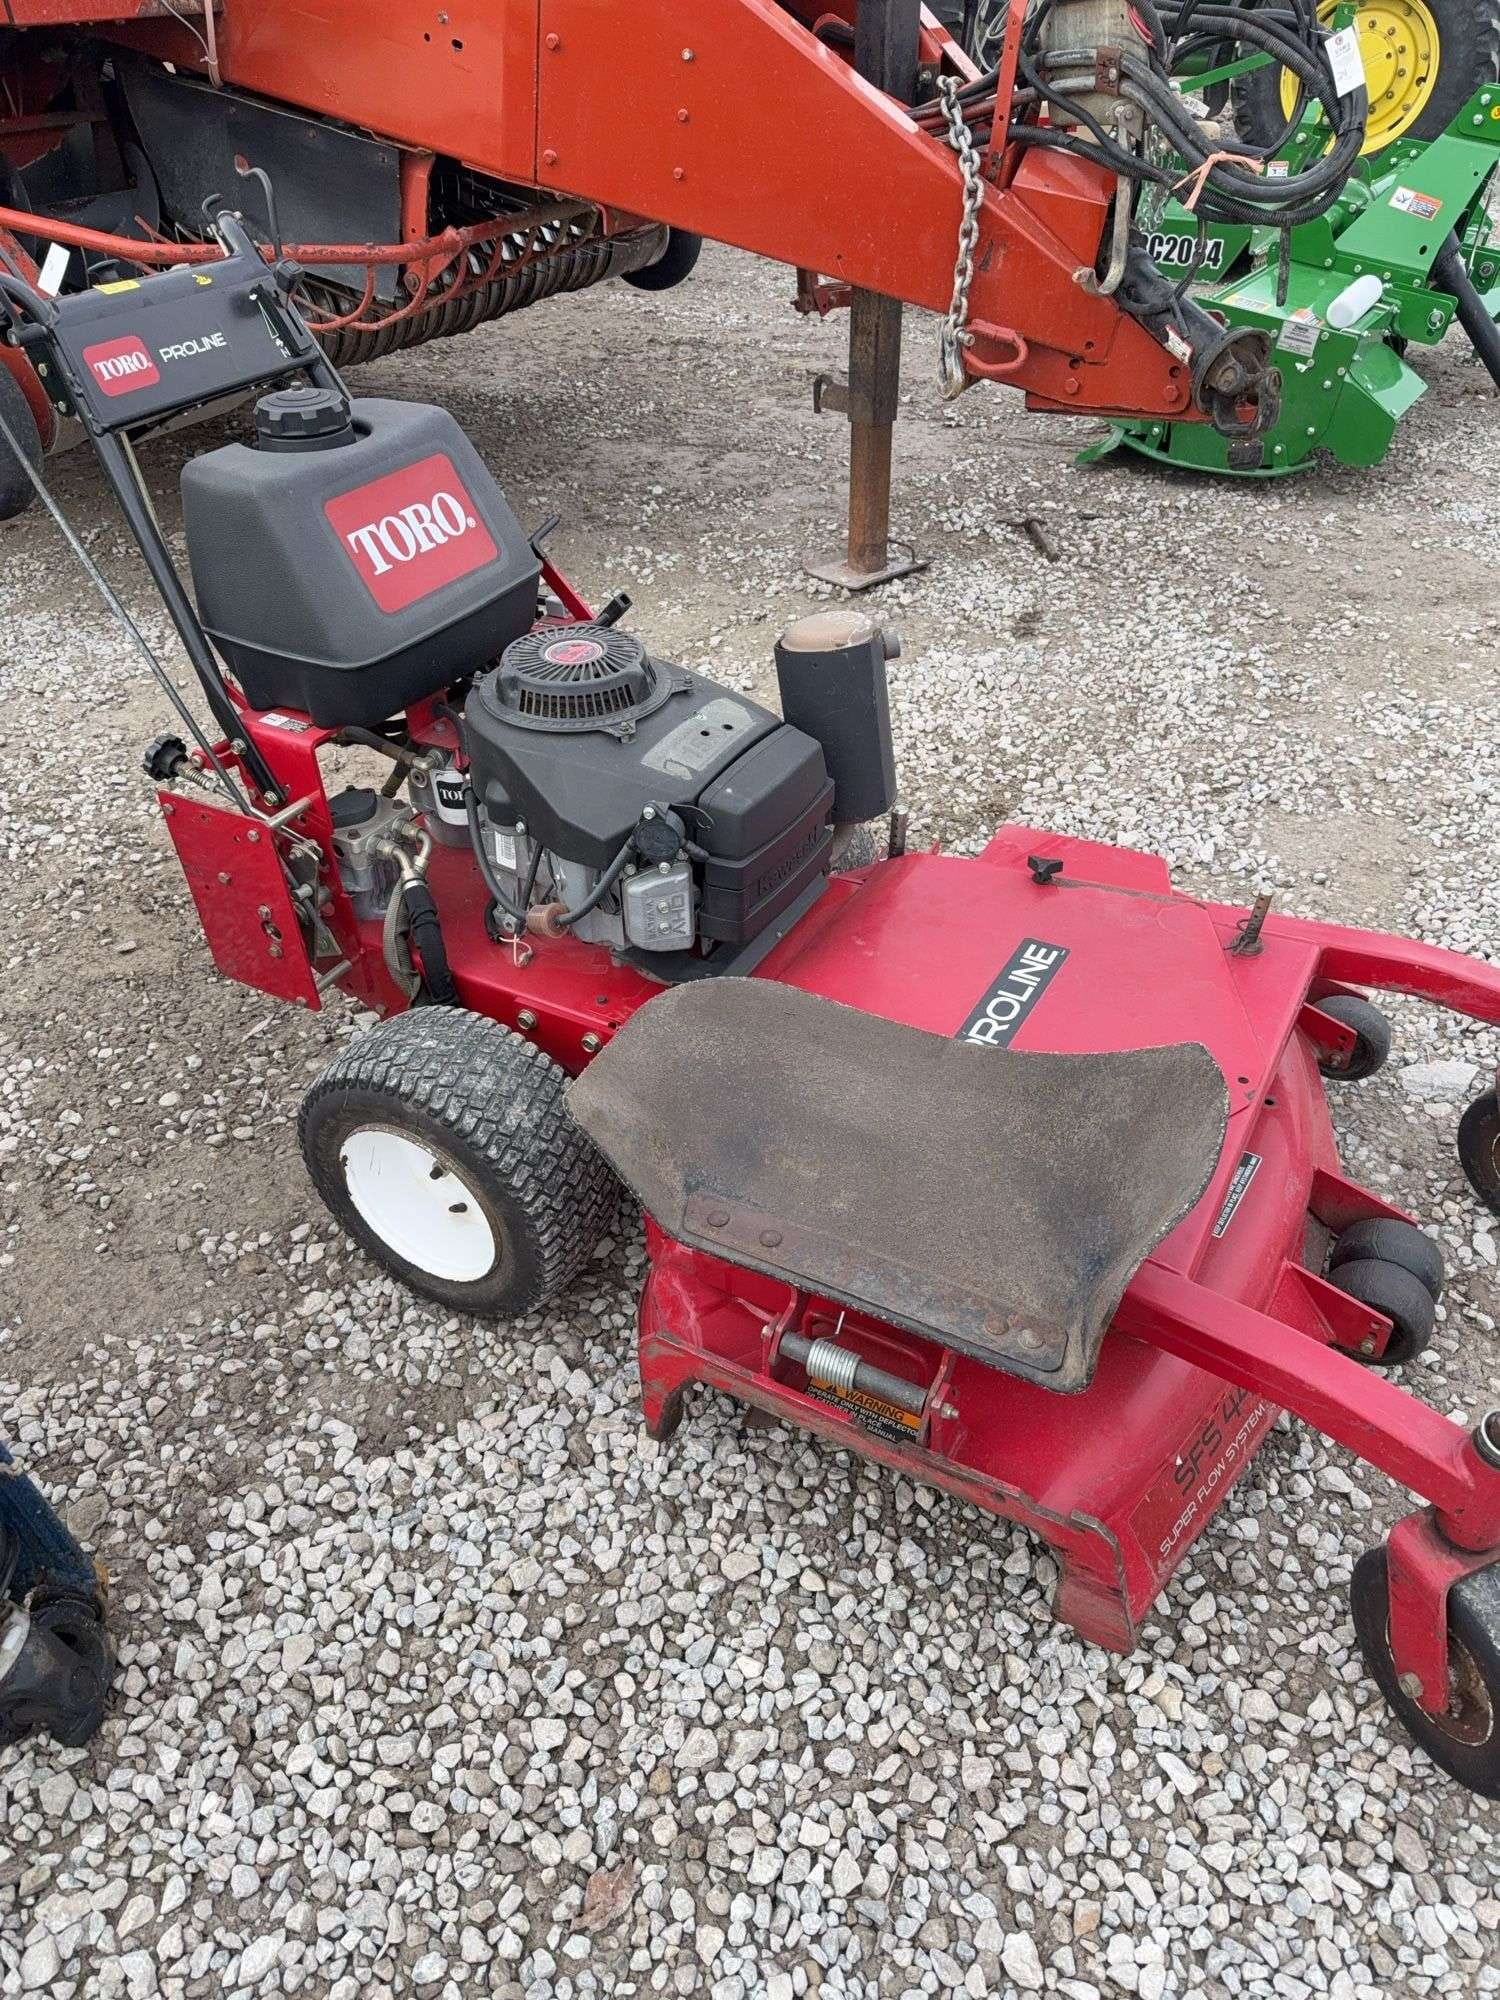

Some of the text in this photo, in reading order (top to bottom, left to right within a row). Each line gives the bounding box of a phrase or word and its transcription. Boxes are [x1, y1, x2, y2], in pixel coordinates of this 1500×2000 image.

[94, 351, 149, 381] TORO
[159, 332, 228, 363] PROLINE
[346, 492, 467, 576] TORO
[806, 1386, 919, 1436] OPERATE ONLY WITH DEFLECTO
[845, 1390, 905, 1420] WARNING
[1160, 1402, 1266, 1558] SUPER FLOW SYSTEM
[1174, 1418, 1222, 1497] SFS
